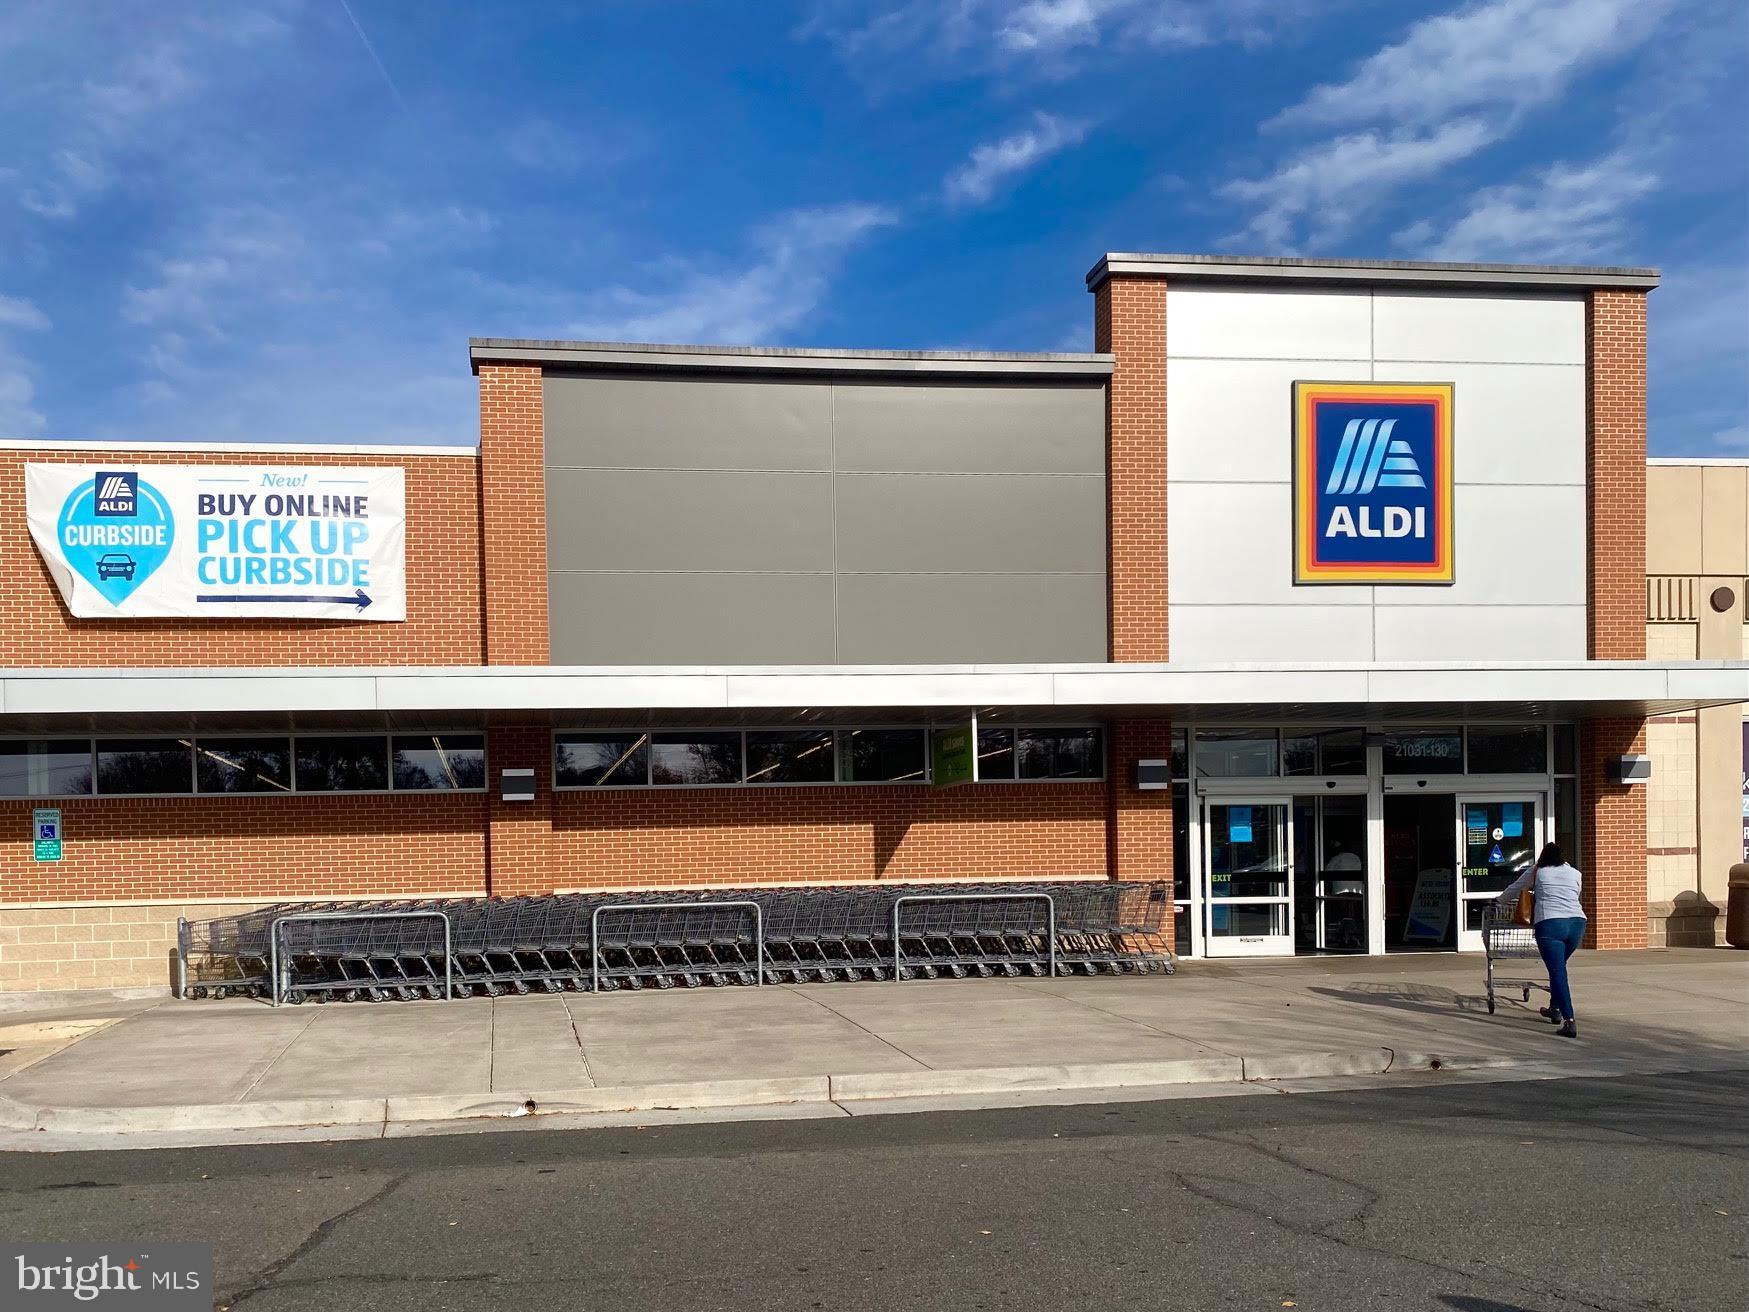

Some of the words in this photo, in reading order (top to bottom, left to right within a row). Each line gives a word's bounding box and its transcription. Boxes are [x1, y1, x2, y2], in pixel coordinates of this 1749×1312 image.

[260, 473, 308, 487] New!
[98, 501, 133, 511] ALDI
[198, 493, 257, 516] BUY
[264, 494, 369, 518] ONLINE
[1325, 506, 1425, 538] ALDI
[65, 524, 167, 547] CURBSIDE
[198, 519, 300, 554] PICK
[310, 520, 369, 555] UP
[198, 556, 370, 586] CURBSIDE
[1212, 874, 1232, 882] EXIT
[1462, 868, 1489, 876] ENTER
